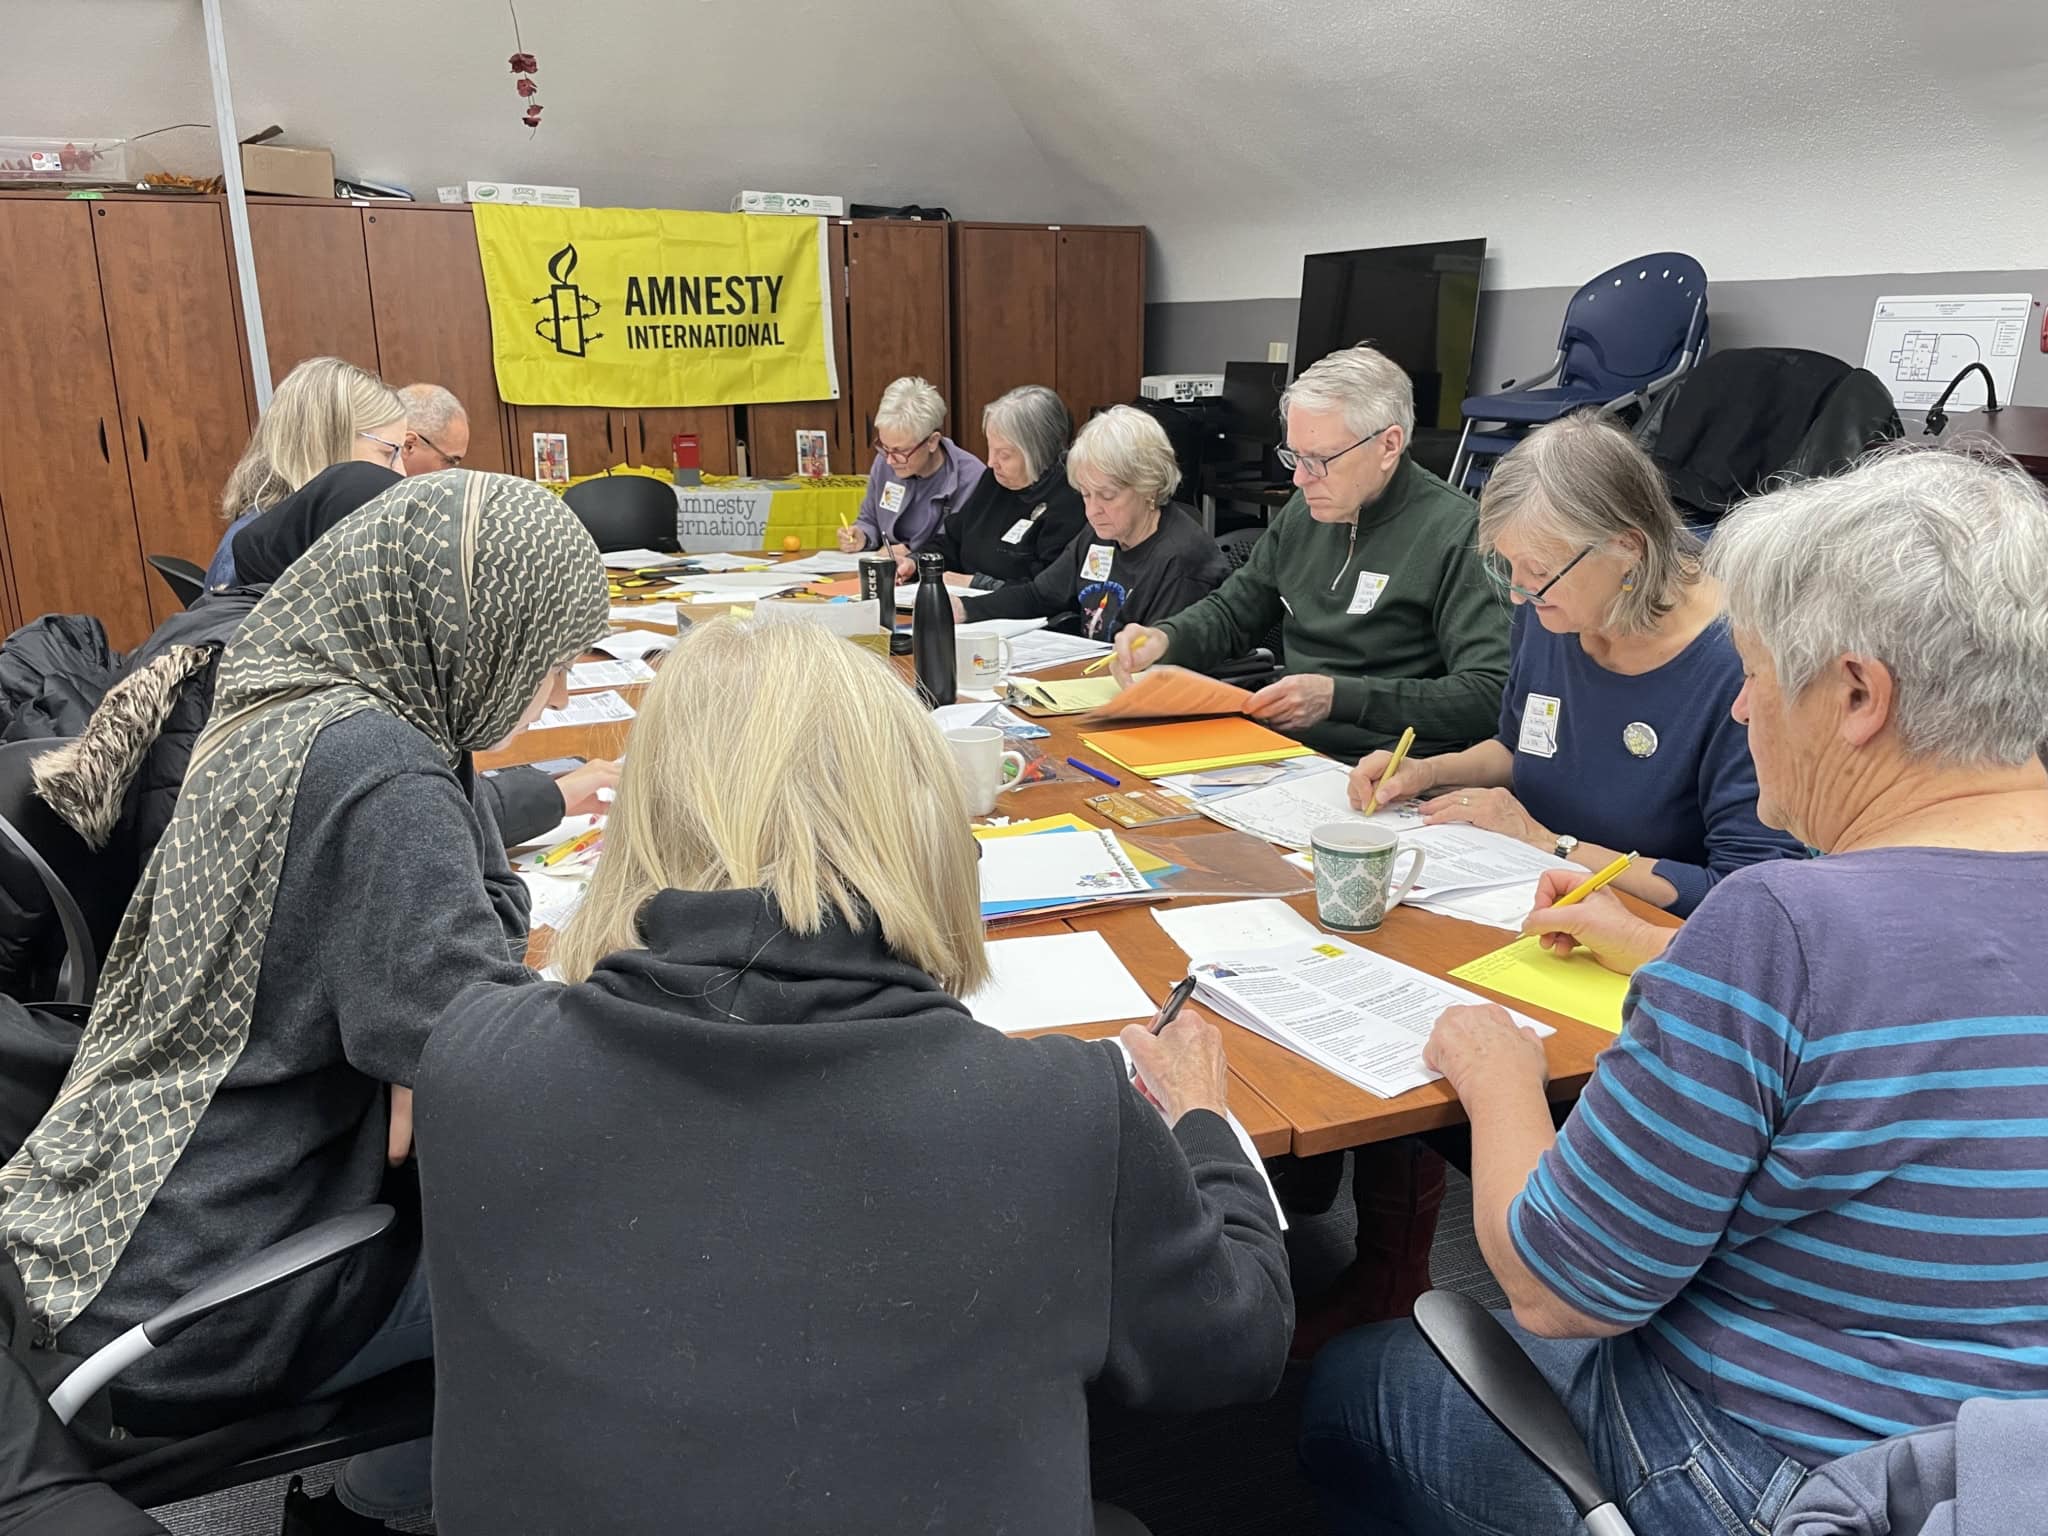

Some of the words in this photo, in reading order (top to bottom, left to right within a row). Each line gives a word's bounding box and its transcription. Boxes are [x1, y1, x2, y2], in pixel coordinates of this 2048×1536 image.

[625, 275, 784, 316] AMNESTY
[627, 322, 785, 350] INTERNATIONAL
[679, 495, 757, 521] mnesty
[677, 516, 769, 537] ernationa
